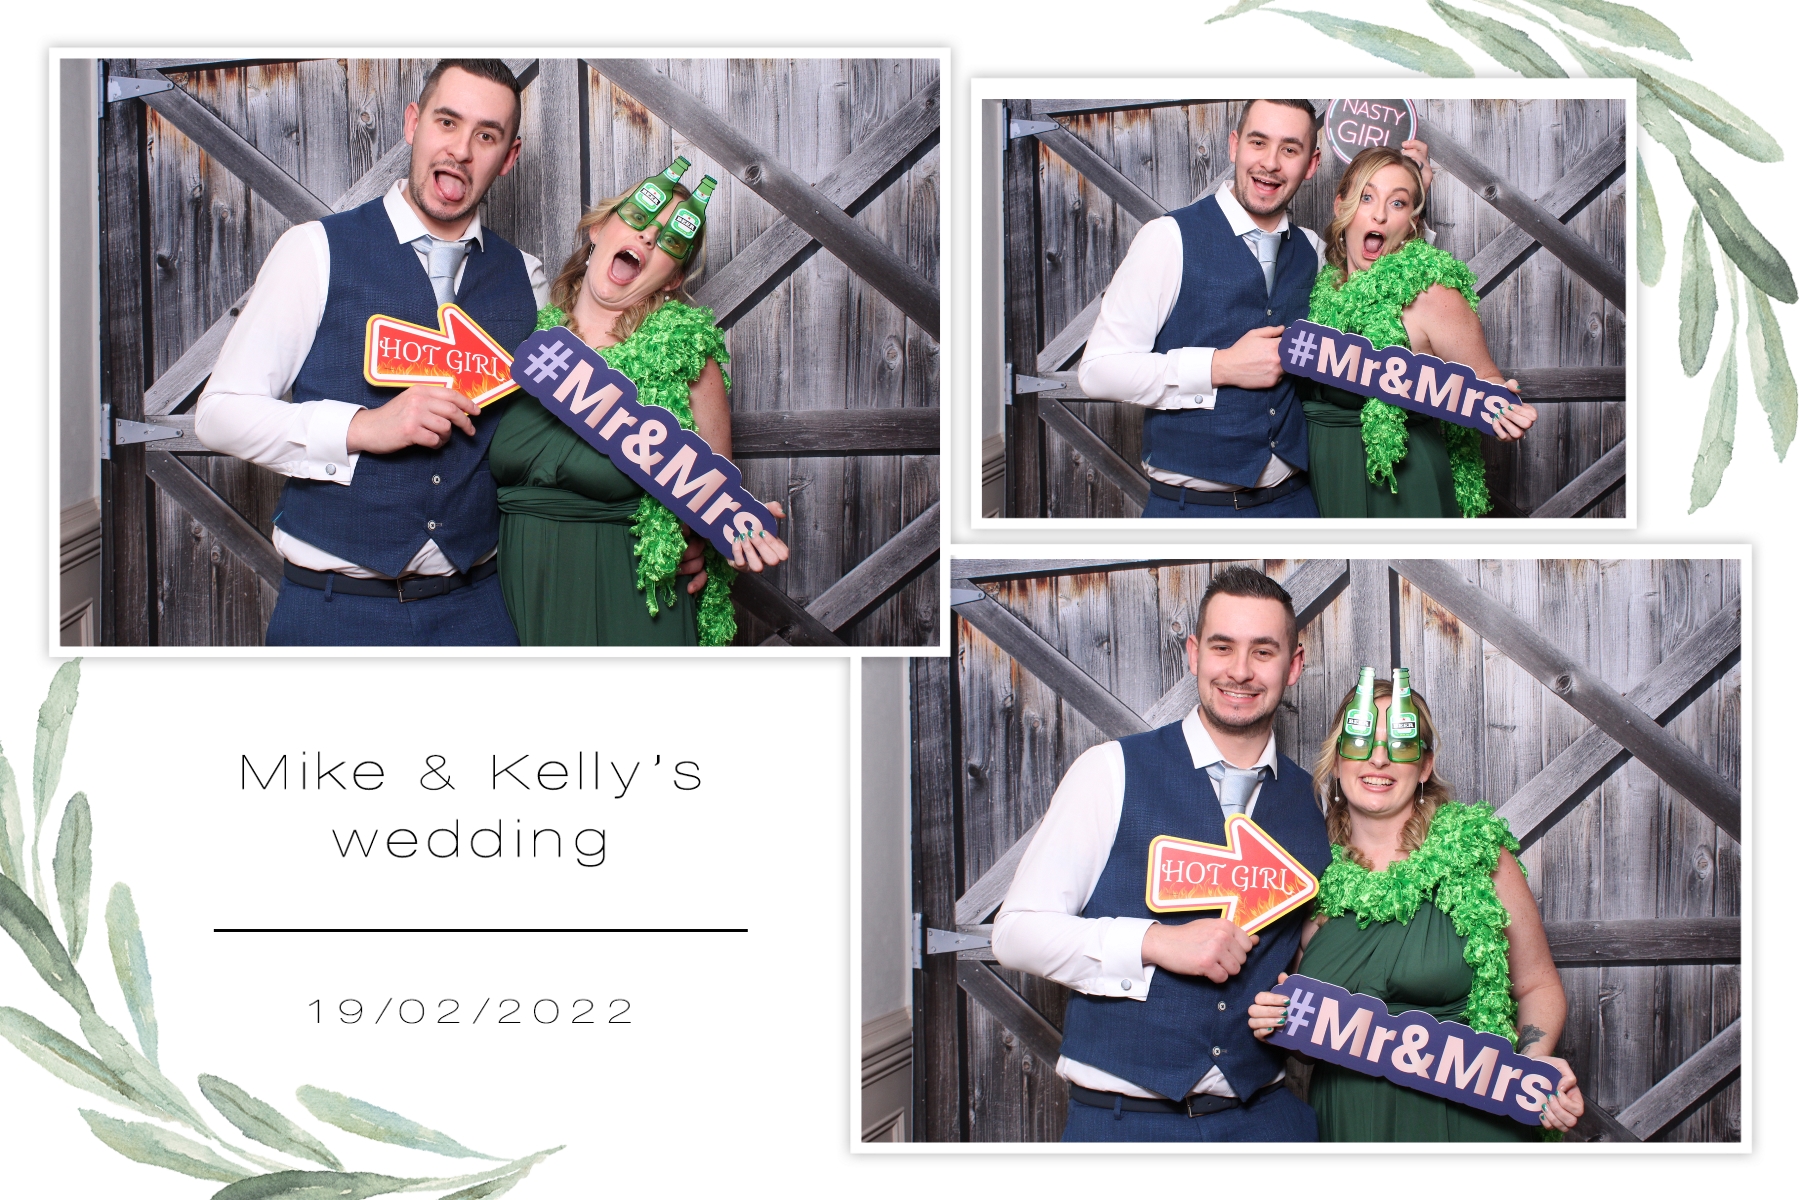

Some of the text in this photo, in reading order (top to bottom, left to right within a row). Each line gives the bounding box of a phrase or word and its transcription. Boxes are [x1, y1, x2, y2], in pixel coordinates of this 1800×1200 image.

[1342, 98, 1406, 126] NASTY
[641, 188, 659, 205] BEER
[677, 216, 695, 231] BEER
[379, 336, 506, 382] HOT GIRL
[1287, 329, 1510, 425] #Mr&Mrs
[523, 340, 764, 545] #Mr&Mrs
[1161, 859, 1293, 896] HOT GIRL
[1276, 988, 1553, 1112] #Mr&Mrs
